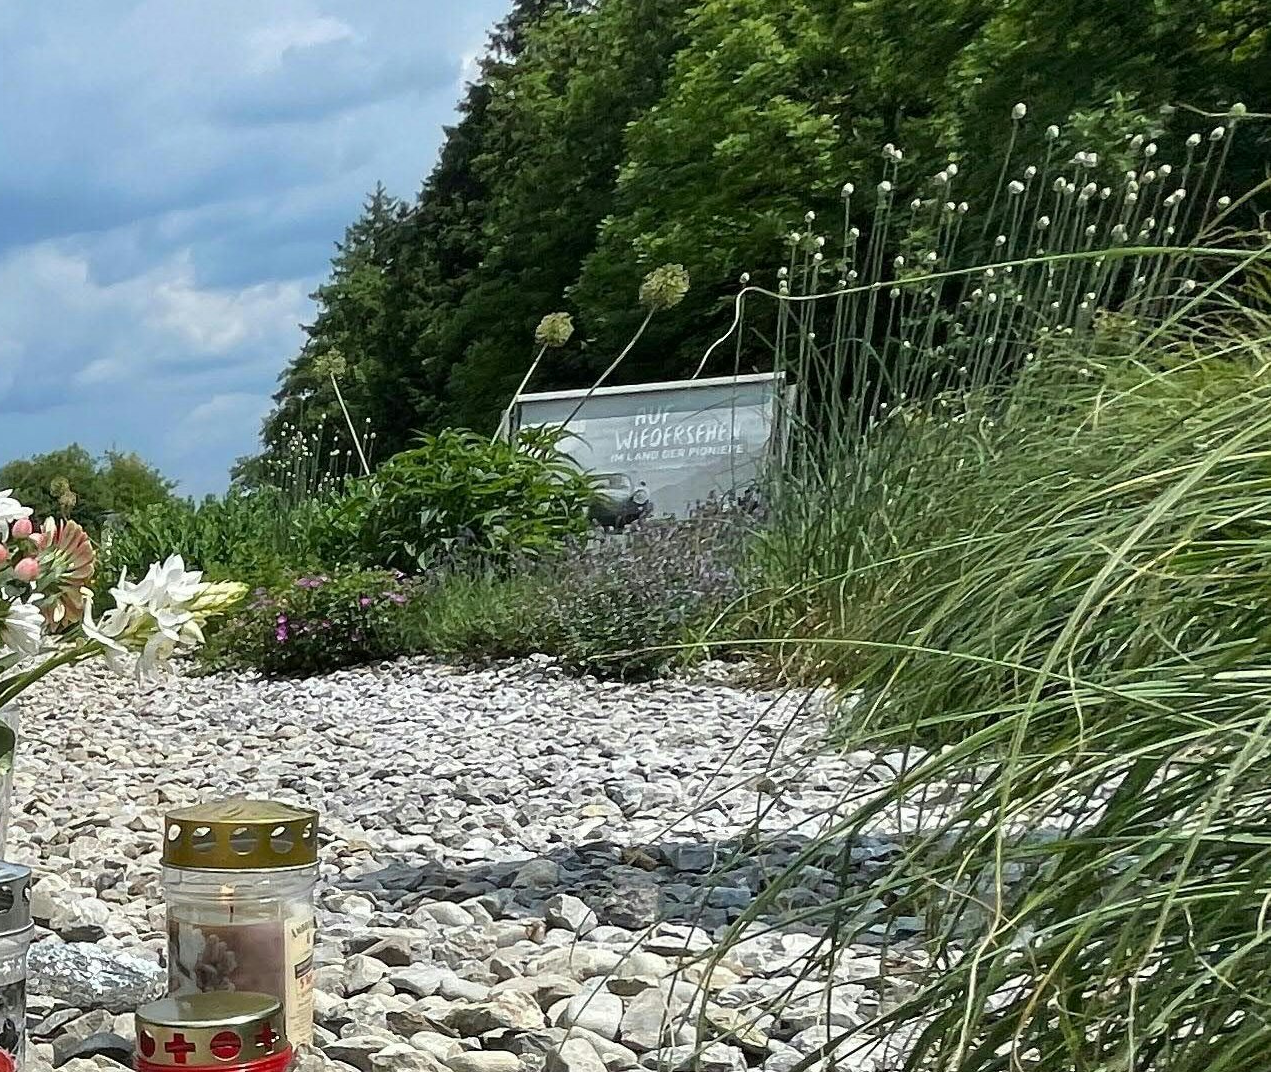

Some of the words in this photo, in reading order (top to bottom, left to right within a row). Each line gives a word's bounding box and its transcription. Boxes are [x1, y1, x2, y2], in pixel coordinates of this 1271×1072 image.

[635, 404, 675, 426] AUF
[616, 417, 742, 450] WIEDERSEHEN
[627, 450, 659, 461] LAND
